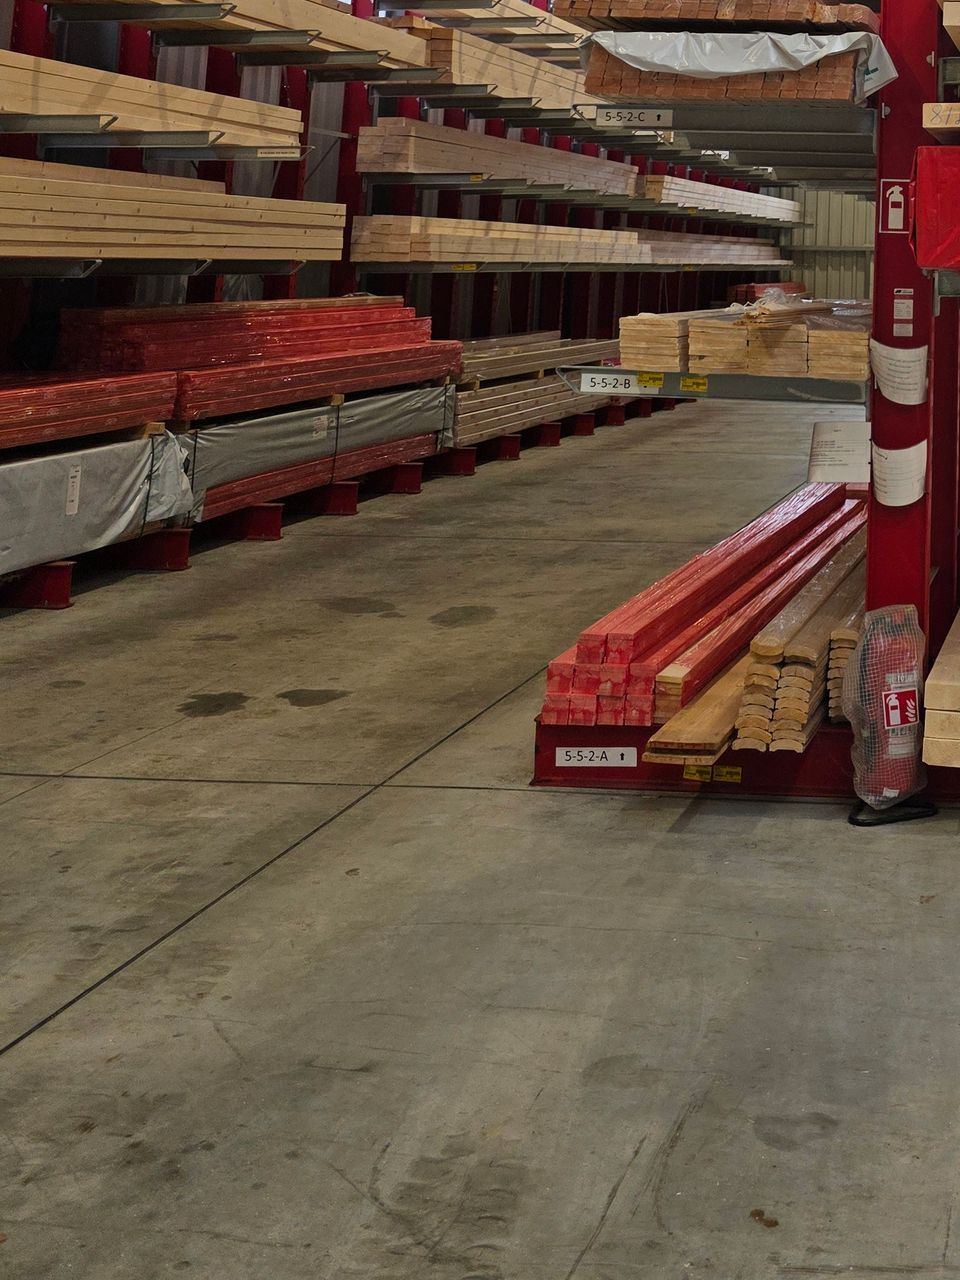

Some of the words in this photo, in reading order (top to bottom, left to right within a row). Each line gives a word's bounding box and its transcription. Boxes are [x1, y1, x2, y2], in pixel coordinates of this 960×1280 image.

[604, 111, 646, 122] 5-5-2-C
[589, 377, 631, 389] 5-5-2-B
[564, 750, 609, 762] 5-5-2-A
